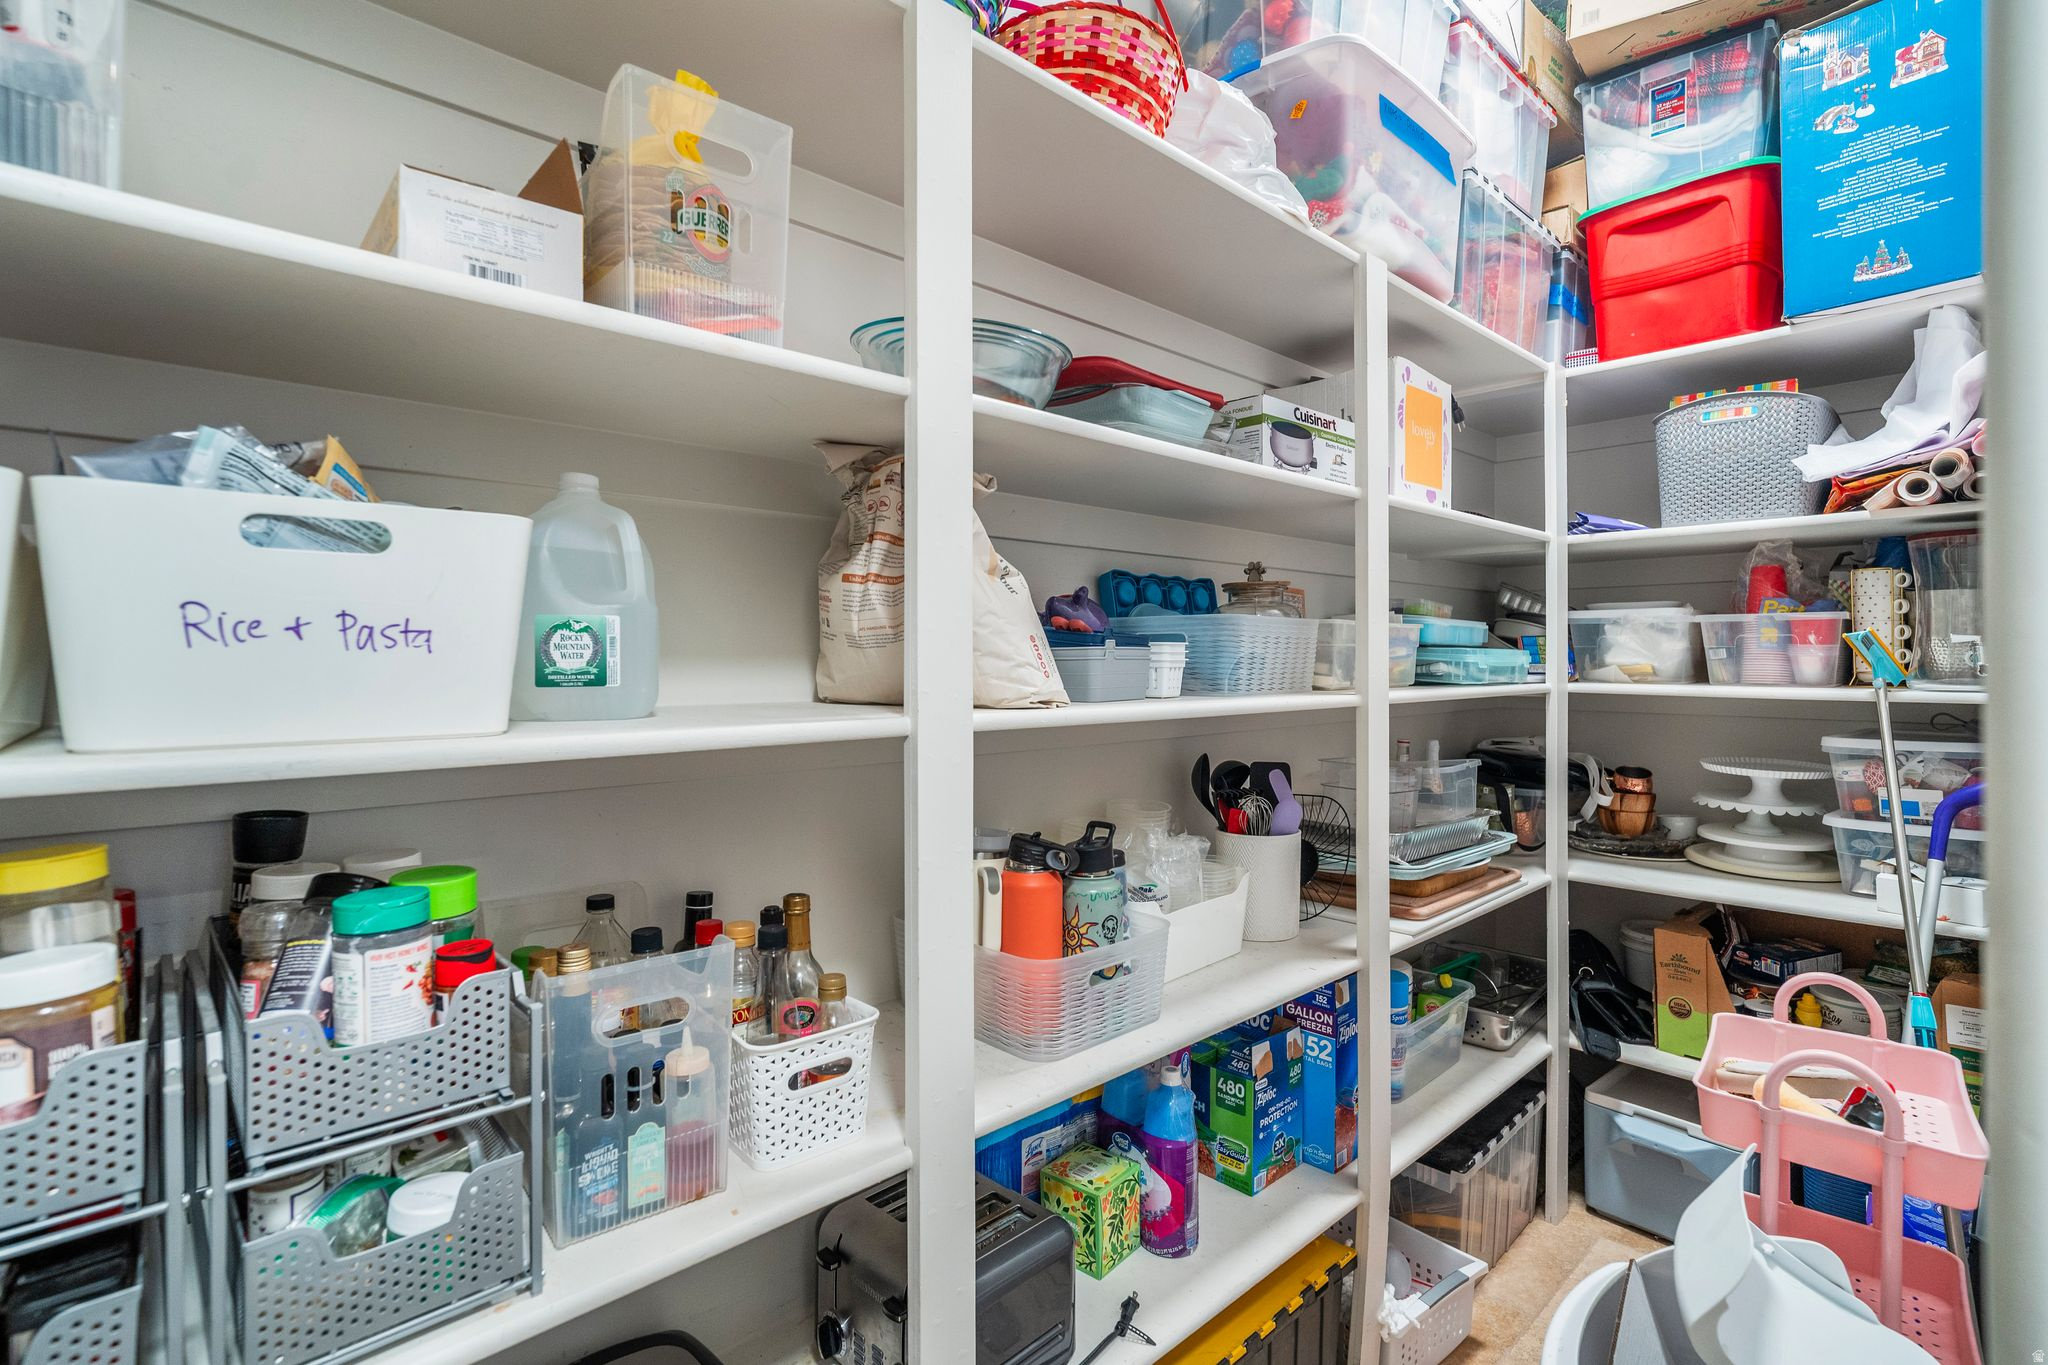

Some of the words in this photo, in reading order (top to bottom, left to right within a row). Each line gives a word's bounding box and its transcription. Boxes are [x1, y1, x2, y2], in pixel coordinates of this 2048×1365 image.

[1293, 407, 1337, 432] Cuisinart
[1412, 420, 1436, 442] lovely
[180, 601, 268, 648] Rice
[284, 616, 312, 640] +
[336, 609, 432, 653] Pasta
[560, 633, 583, 642] ROCKY
[553, 642, 591, 652] MOUNTAIN
[560, 652, 585, 660] WATER
[1659, 962, 1701, 976] Earthbound
[1315, 994, 1328, 1004] 152
[1286, 1003, 1333, 1026] GALLON
[1297, 1017, 1333, 1034] FREEZER
[1242, 1047, 1250, 1055] 4
[1231, 1059, 1249, 1071] 480
[1303, 1055, 1314, 1063] TAL
[1317, 1060, 1332, 1069] BAGS
[1289, 1063, 1302, 1078] 480
[1217, 1077, 1245, 1098] 480
[1217, 1092, 1244, 1105] SANDWICH
[1257, 1088, 1277, 1106] Ziploc
[1260, 1099, 1298, 1128] PROTECTION
[1275, 1137, 1285, 1151] 3X
[1216, 1144, 1248, 1162] EasyGuide
